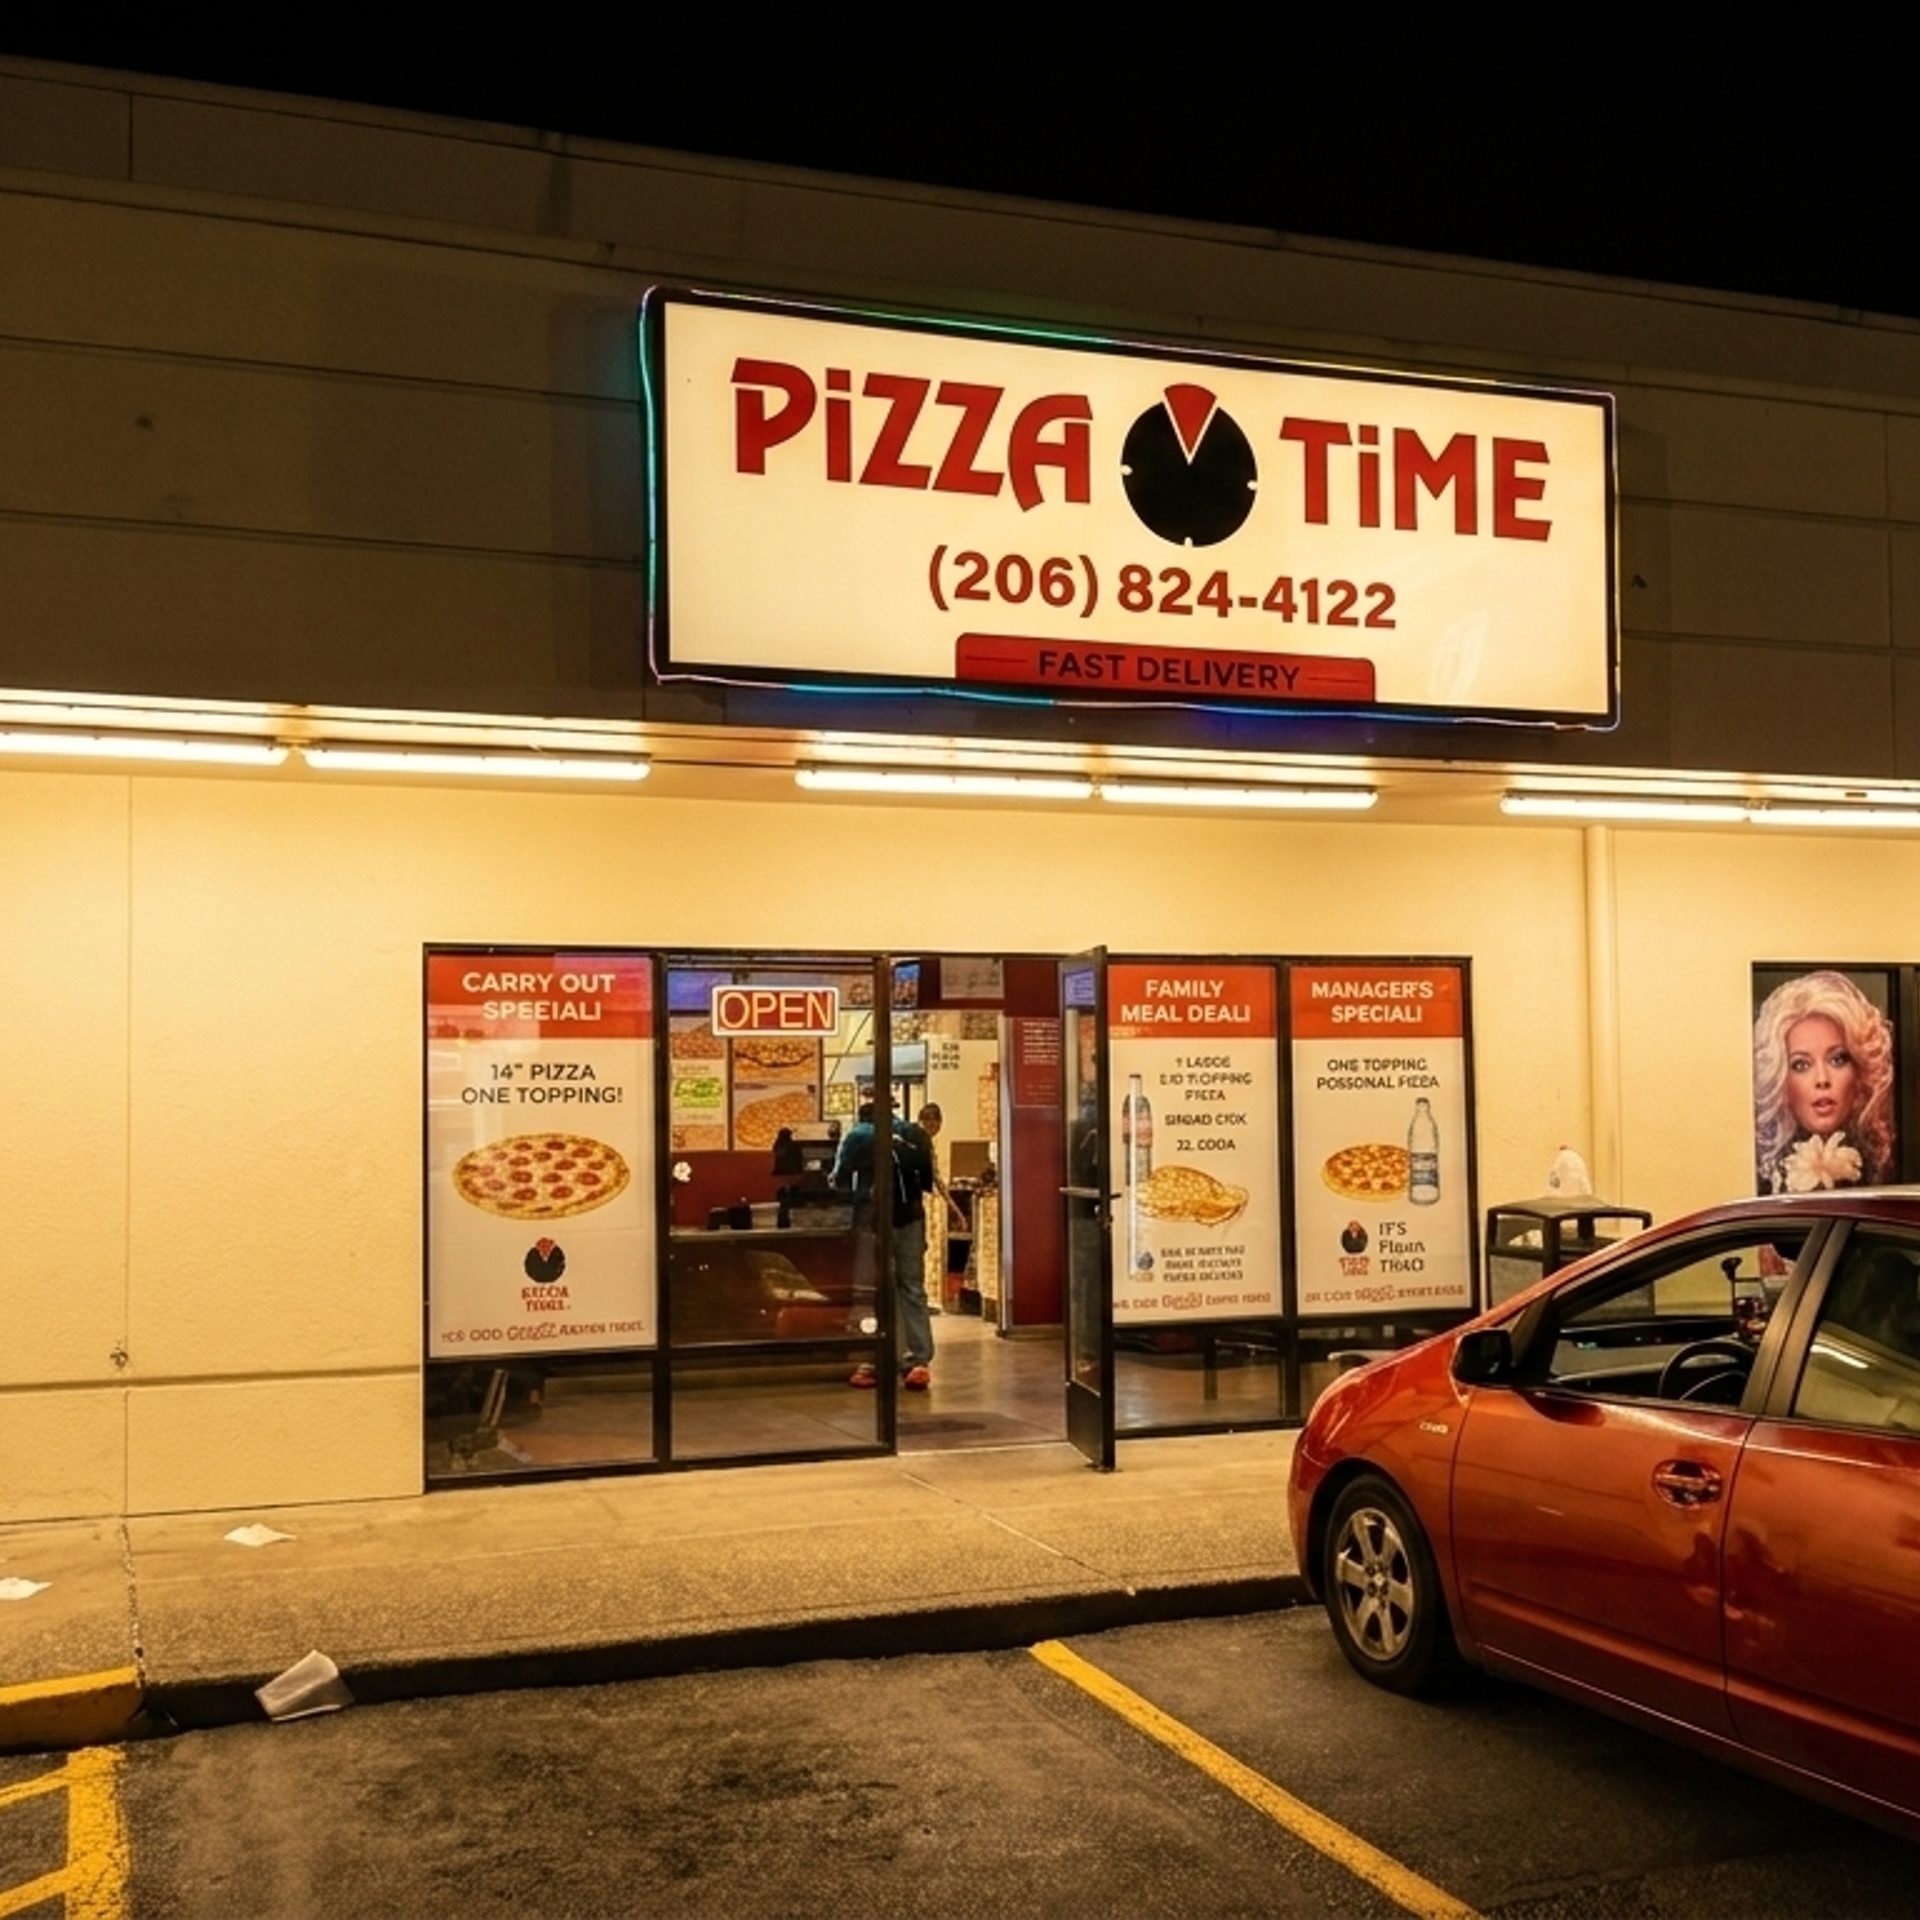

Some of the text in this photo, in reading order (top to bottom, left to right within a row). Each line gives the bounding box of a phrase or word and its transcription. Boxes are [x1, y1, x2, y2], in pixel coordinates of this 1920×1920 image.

[929, 544, 1397, 630] (206) 824-4122
[1038, 650, 1301, 691] FAST DELIVERY
[462, 971, 616, 993] CARRY OUT
[1145, 979, 1224, 998] FAMILY
[719, 991, 832, 1029] OPEN
[1121, 1004, 1183, 1022] MEAL
[530, 1063, 596, 1080] PIZZA
[461, 1086, 624, 1104] ONE TOPPING!
